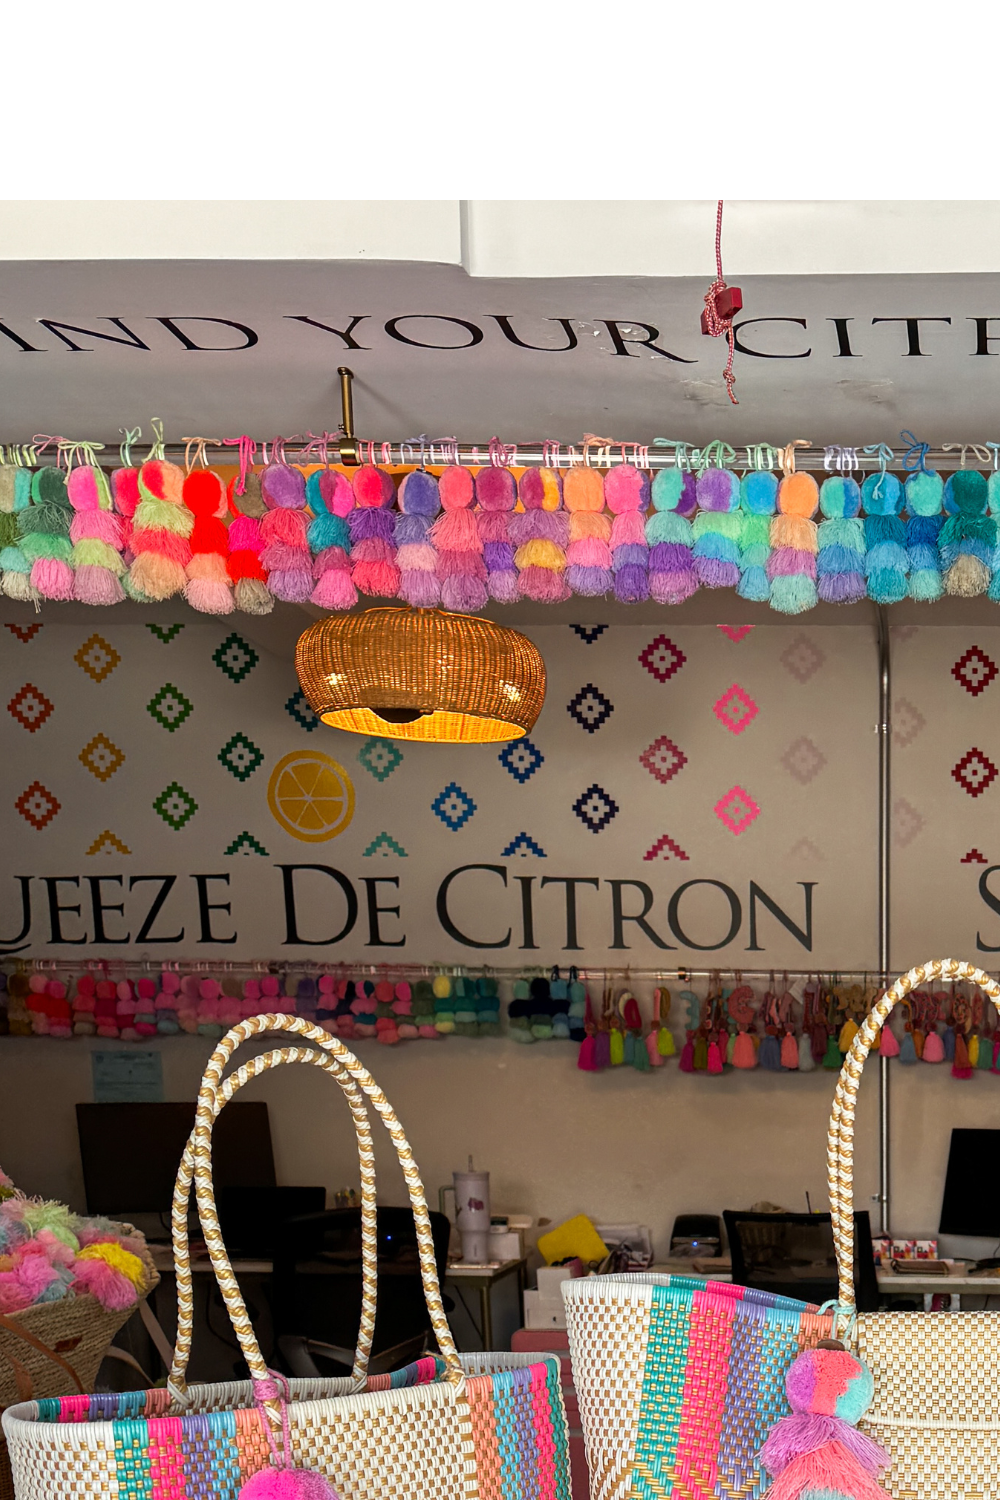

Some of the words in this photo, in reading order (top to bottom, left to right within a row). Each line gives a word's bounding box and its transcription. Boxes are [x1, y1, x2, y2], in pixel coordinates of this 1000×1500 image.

[283, 314, 699, 363] YOUR
[274, 864, 406, 946] DE
[436, 864, 818, 952] CITRON
